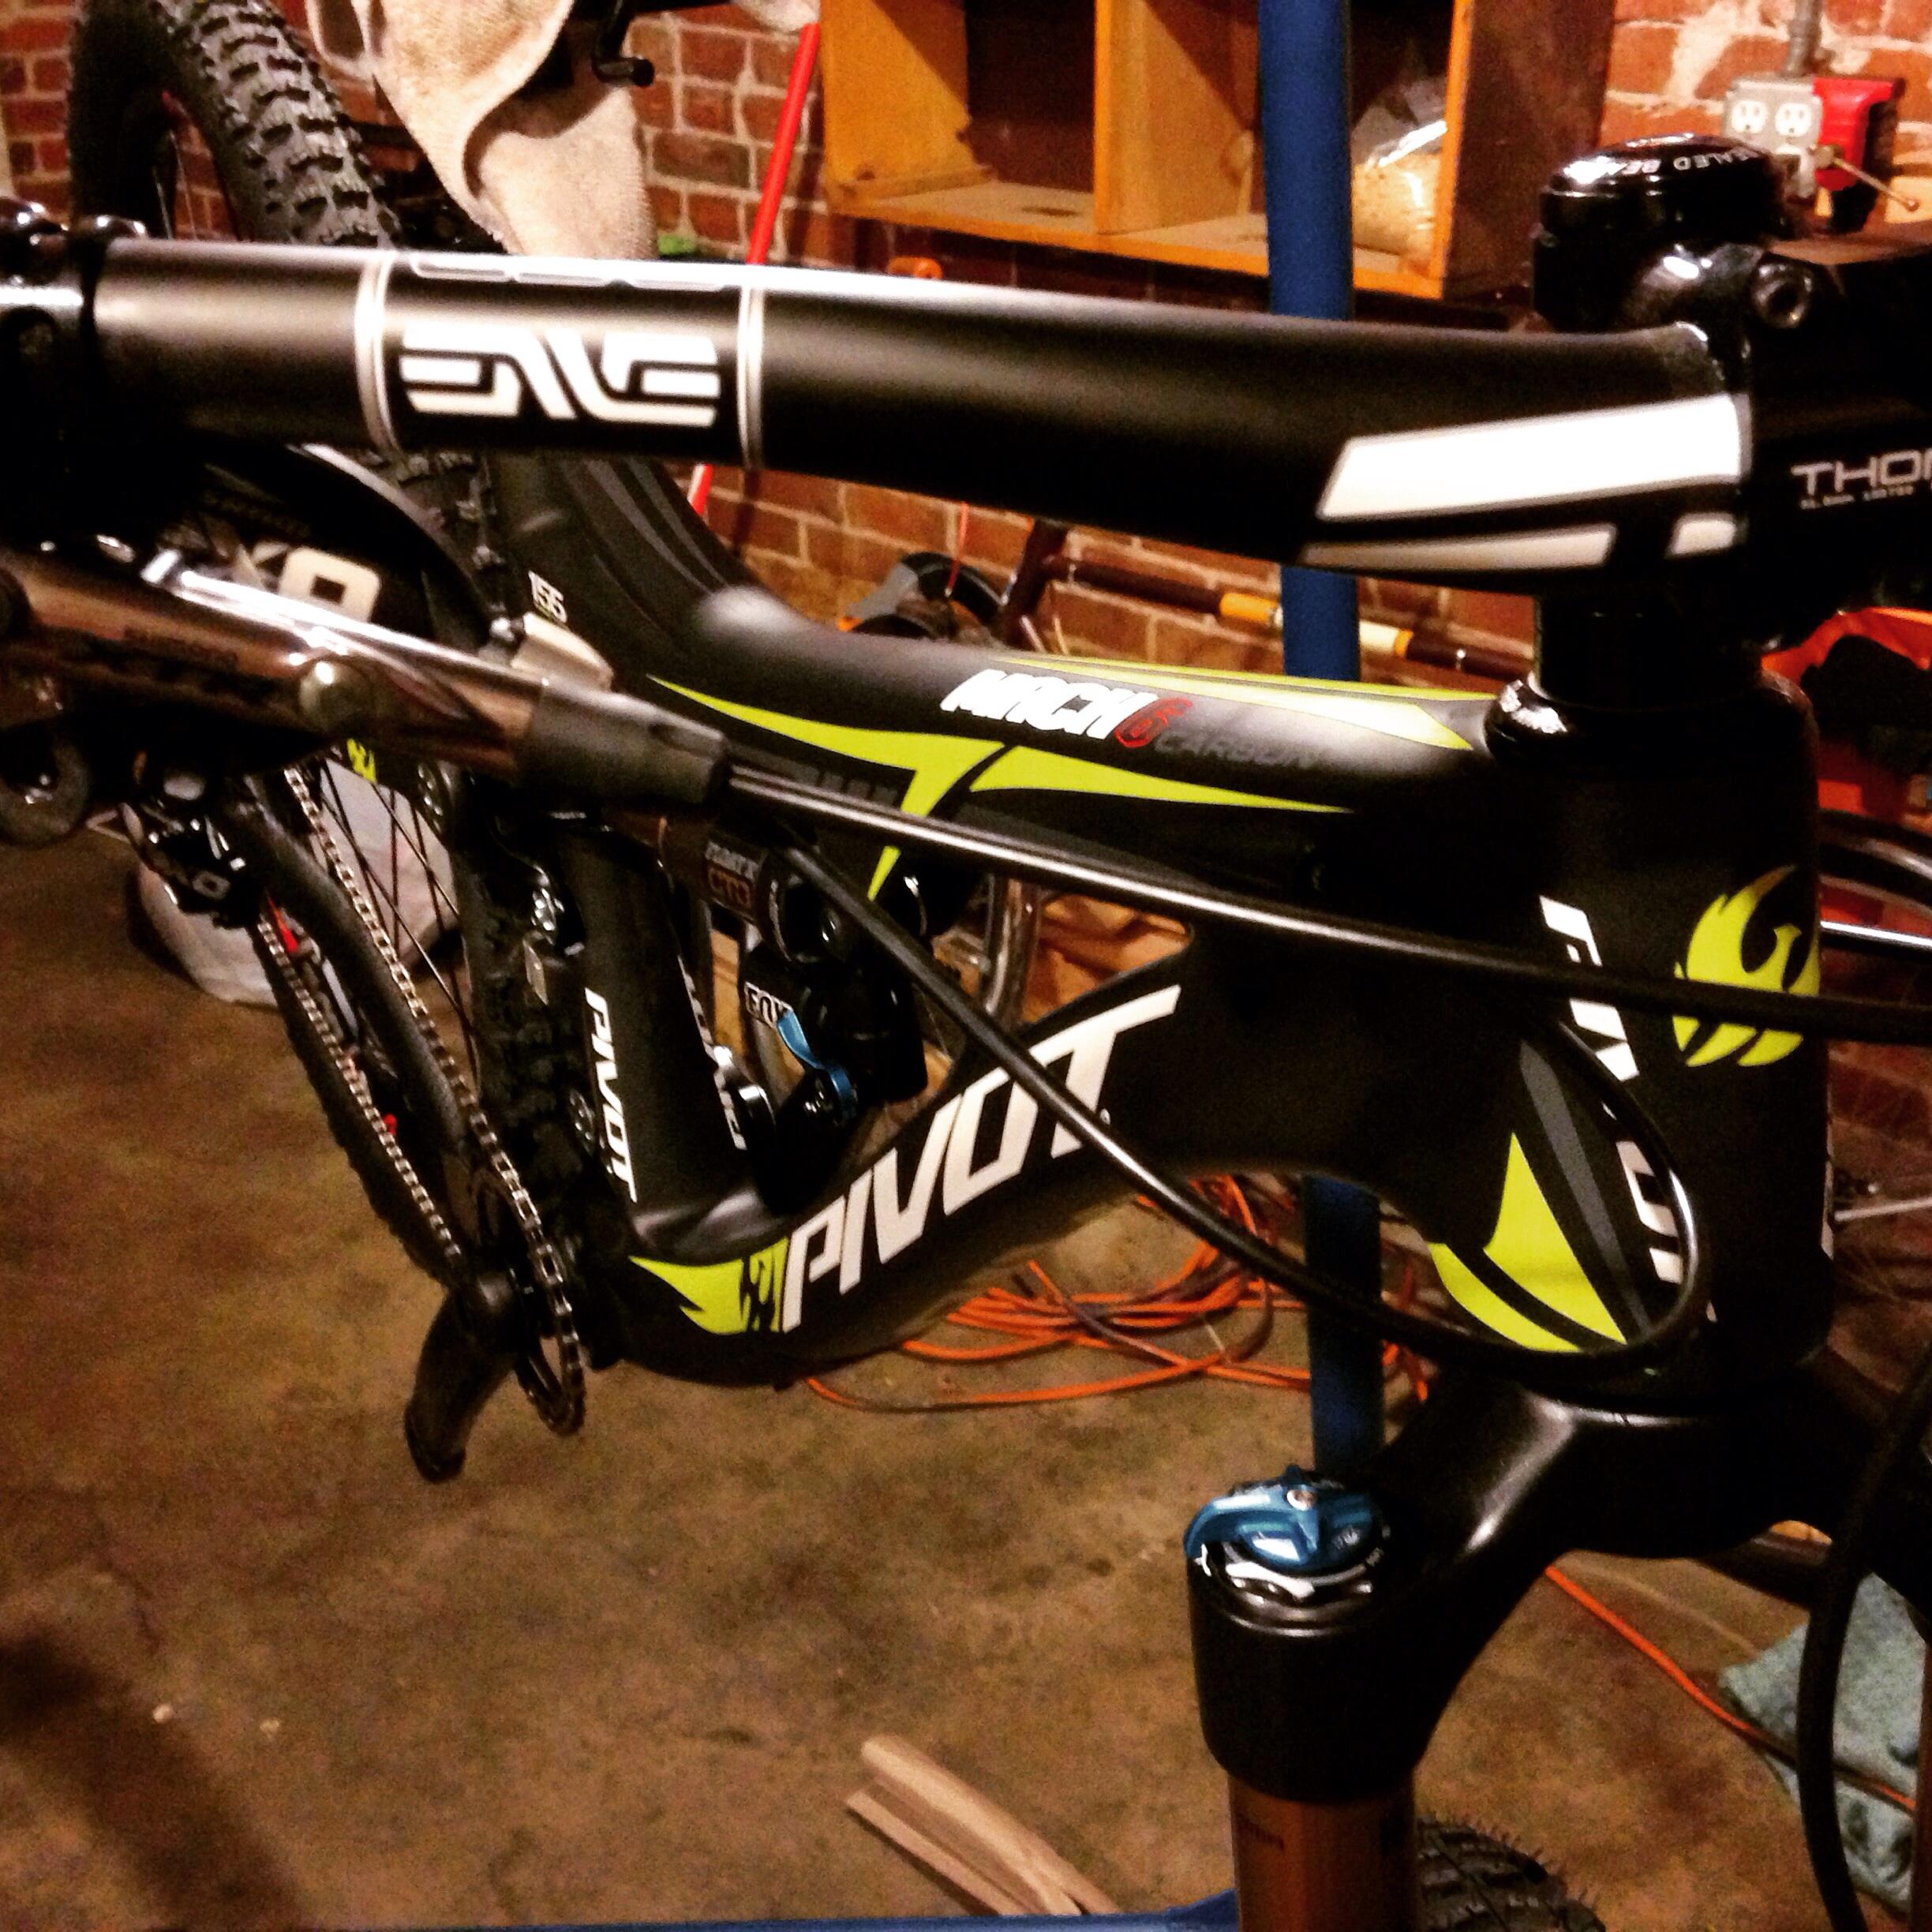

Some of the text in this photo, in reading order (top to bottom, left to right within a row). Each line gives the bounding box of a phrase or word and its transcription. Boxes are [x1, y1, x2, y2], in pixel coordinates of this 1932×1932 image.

[1790, 448, 1932, 496] THO
[939, 668, 1161, 739] MACH
[585, 987, 638, 1204] PIVOT
[783, 984, 1182, 1334] PIVOT
